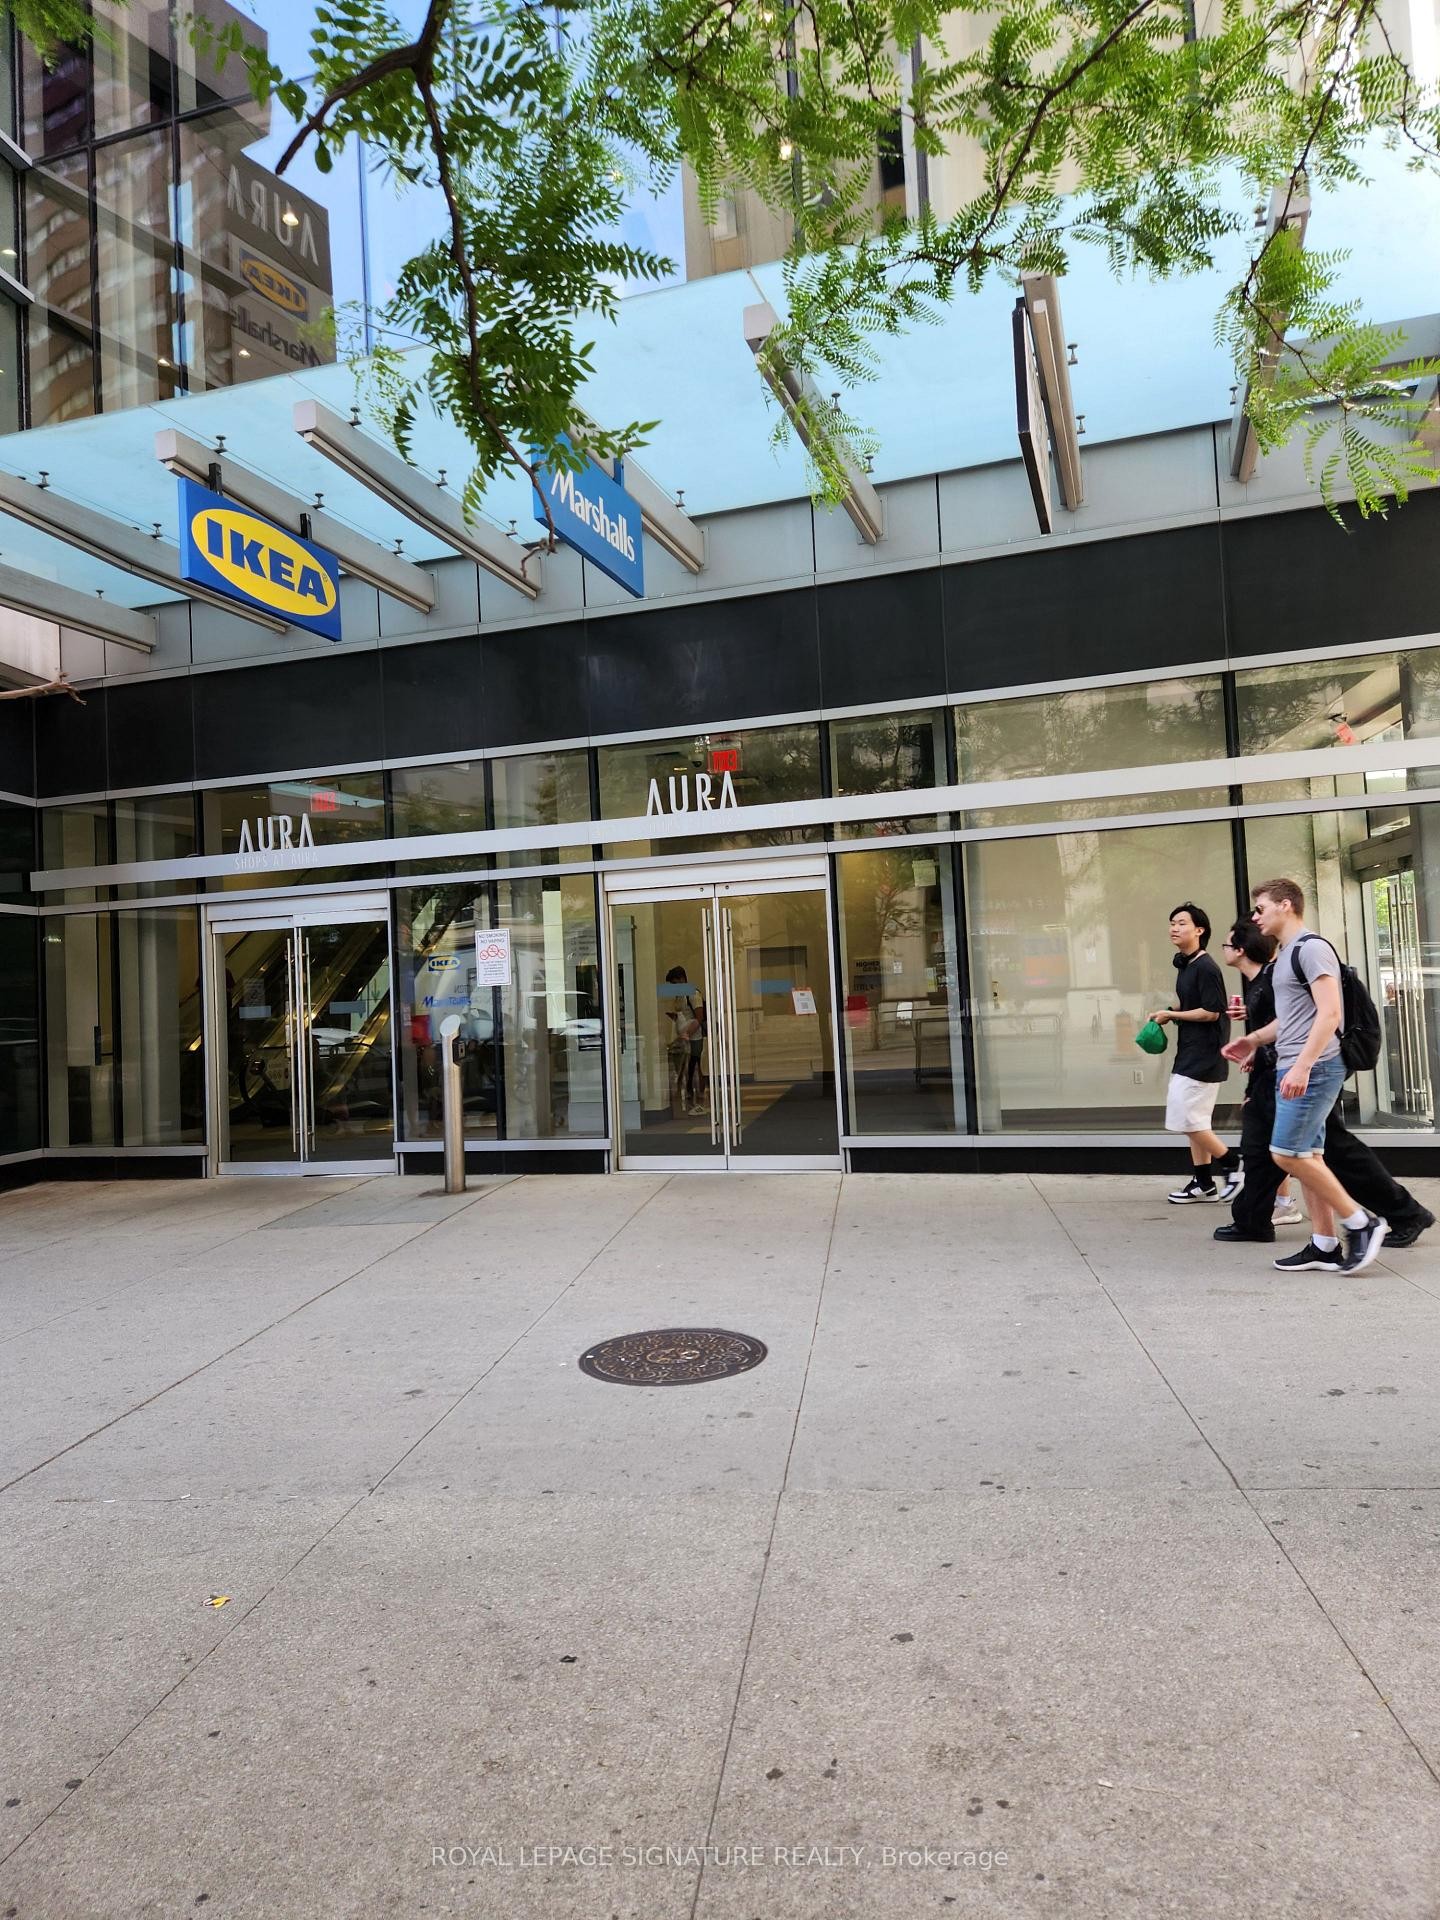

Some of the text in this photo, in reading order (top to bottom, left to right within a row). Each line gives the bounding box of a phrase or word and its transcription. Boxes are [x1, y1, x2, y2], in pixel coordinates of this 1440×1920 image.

[551, 468, 636, 563] Marshalls
[206, 517, 328, 607] IKEA
[646, 771, 738, 815] AURA
[239, 813, 314, 853] AURA
